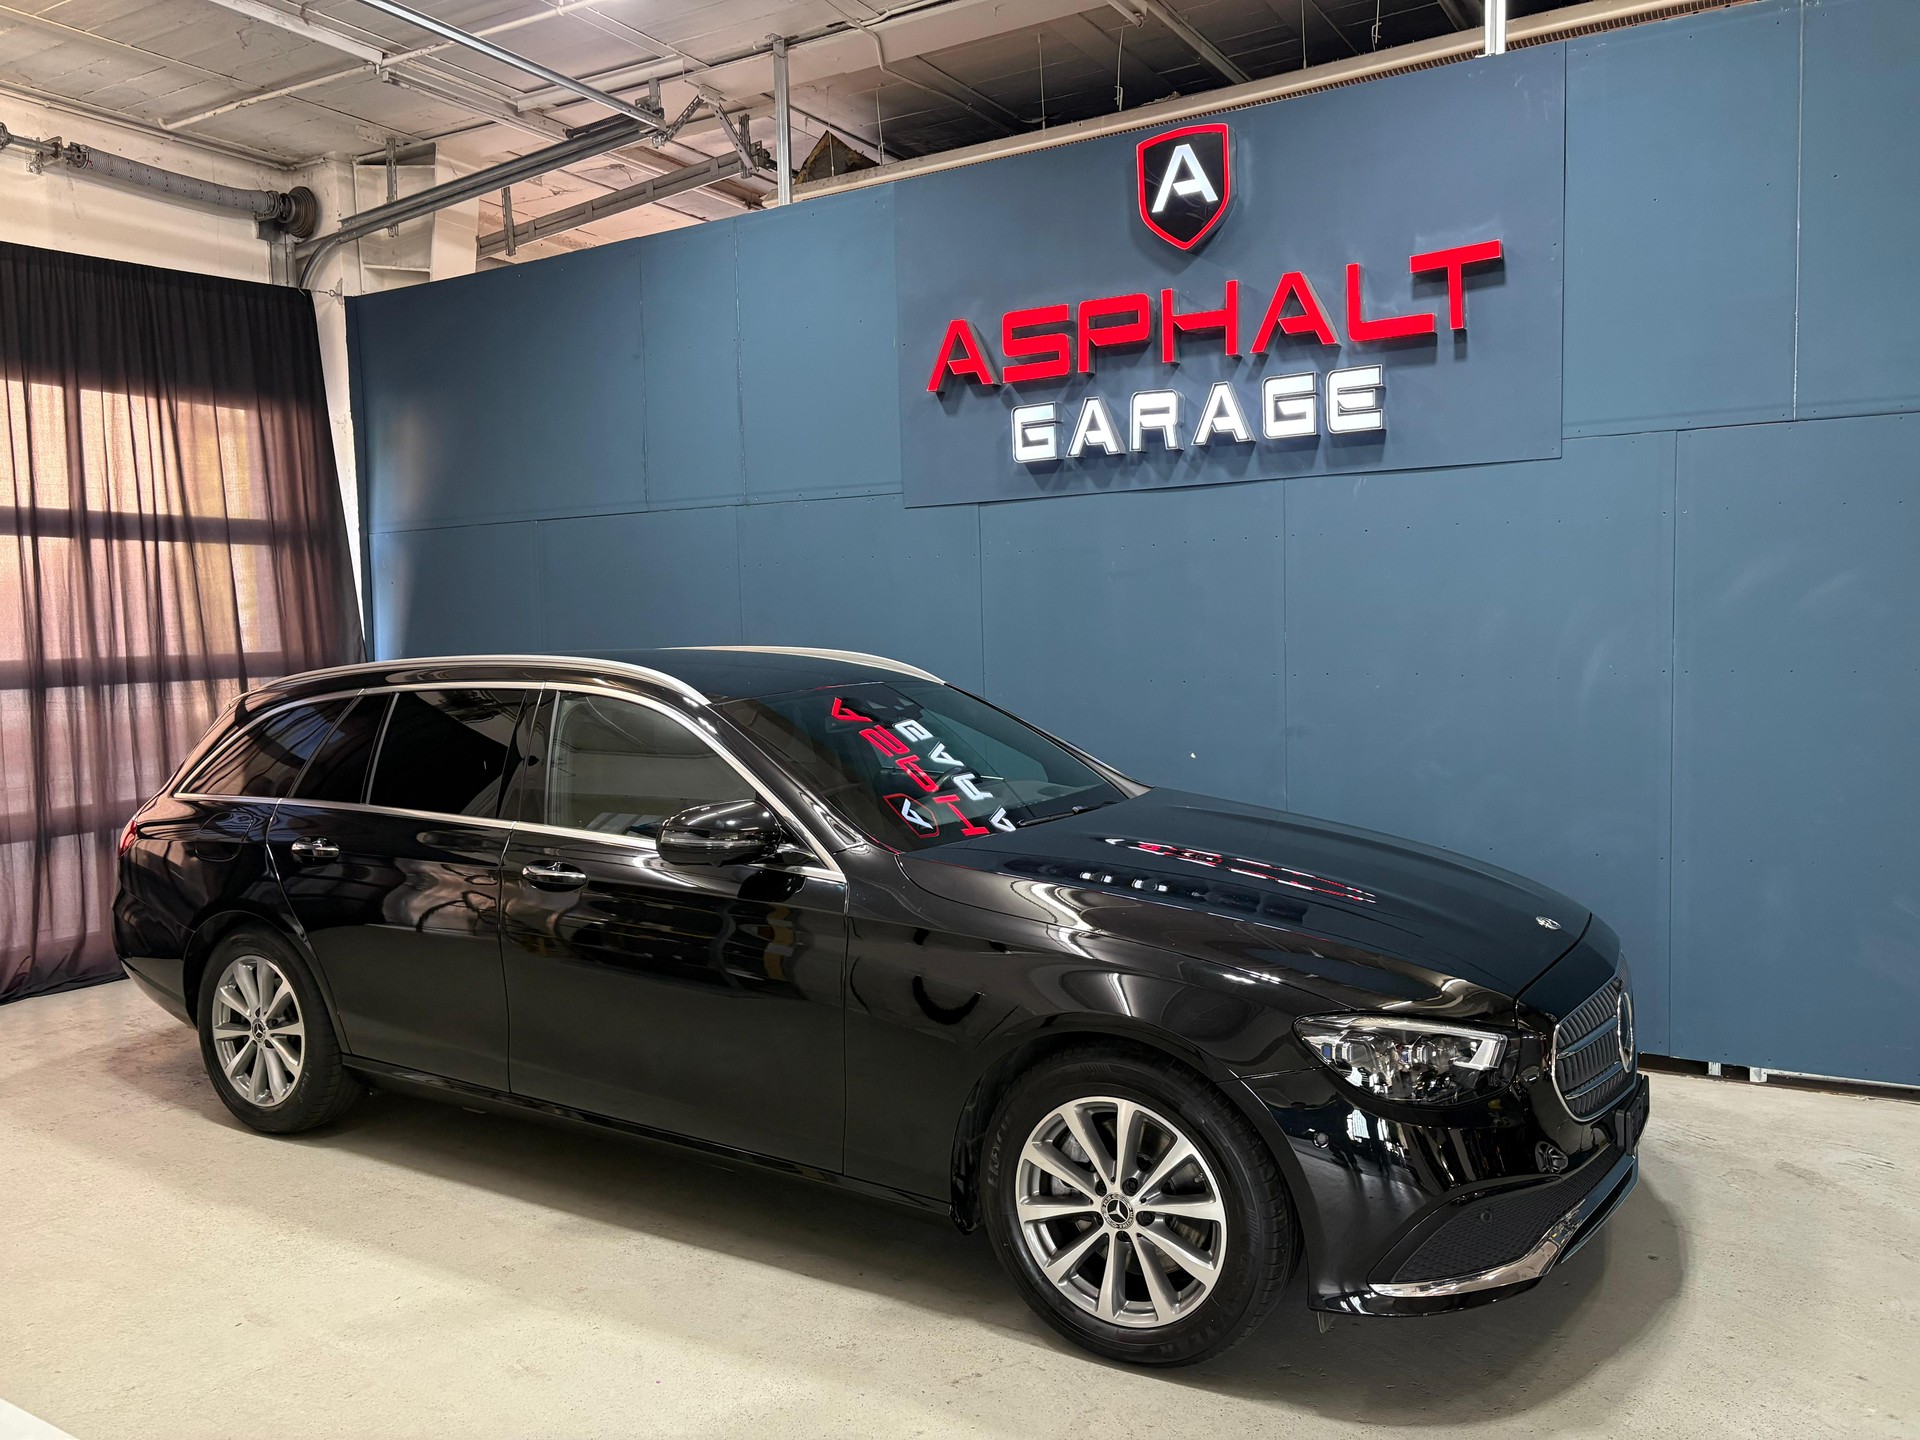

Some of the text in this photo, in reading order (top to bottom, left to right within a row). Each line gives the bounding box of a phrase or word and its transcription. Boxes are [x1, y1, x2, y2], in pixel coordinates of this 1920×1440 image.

[1152, 143, 1219, 213] A
[926, 239, 1503, 392] ASPHALT
[1011, 363, 1385, 464] GARAGE
